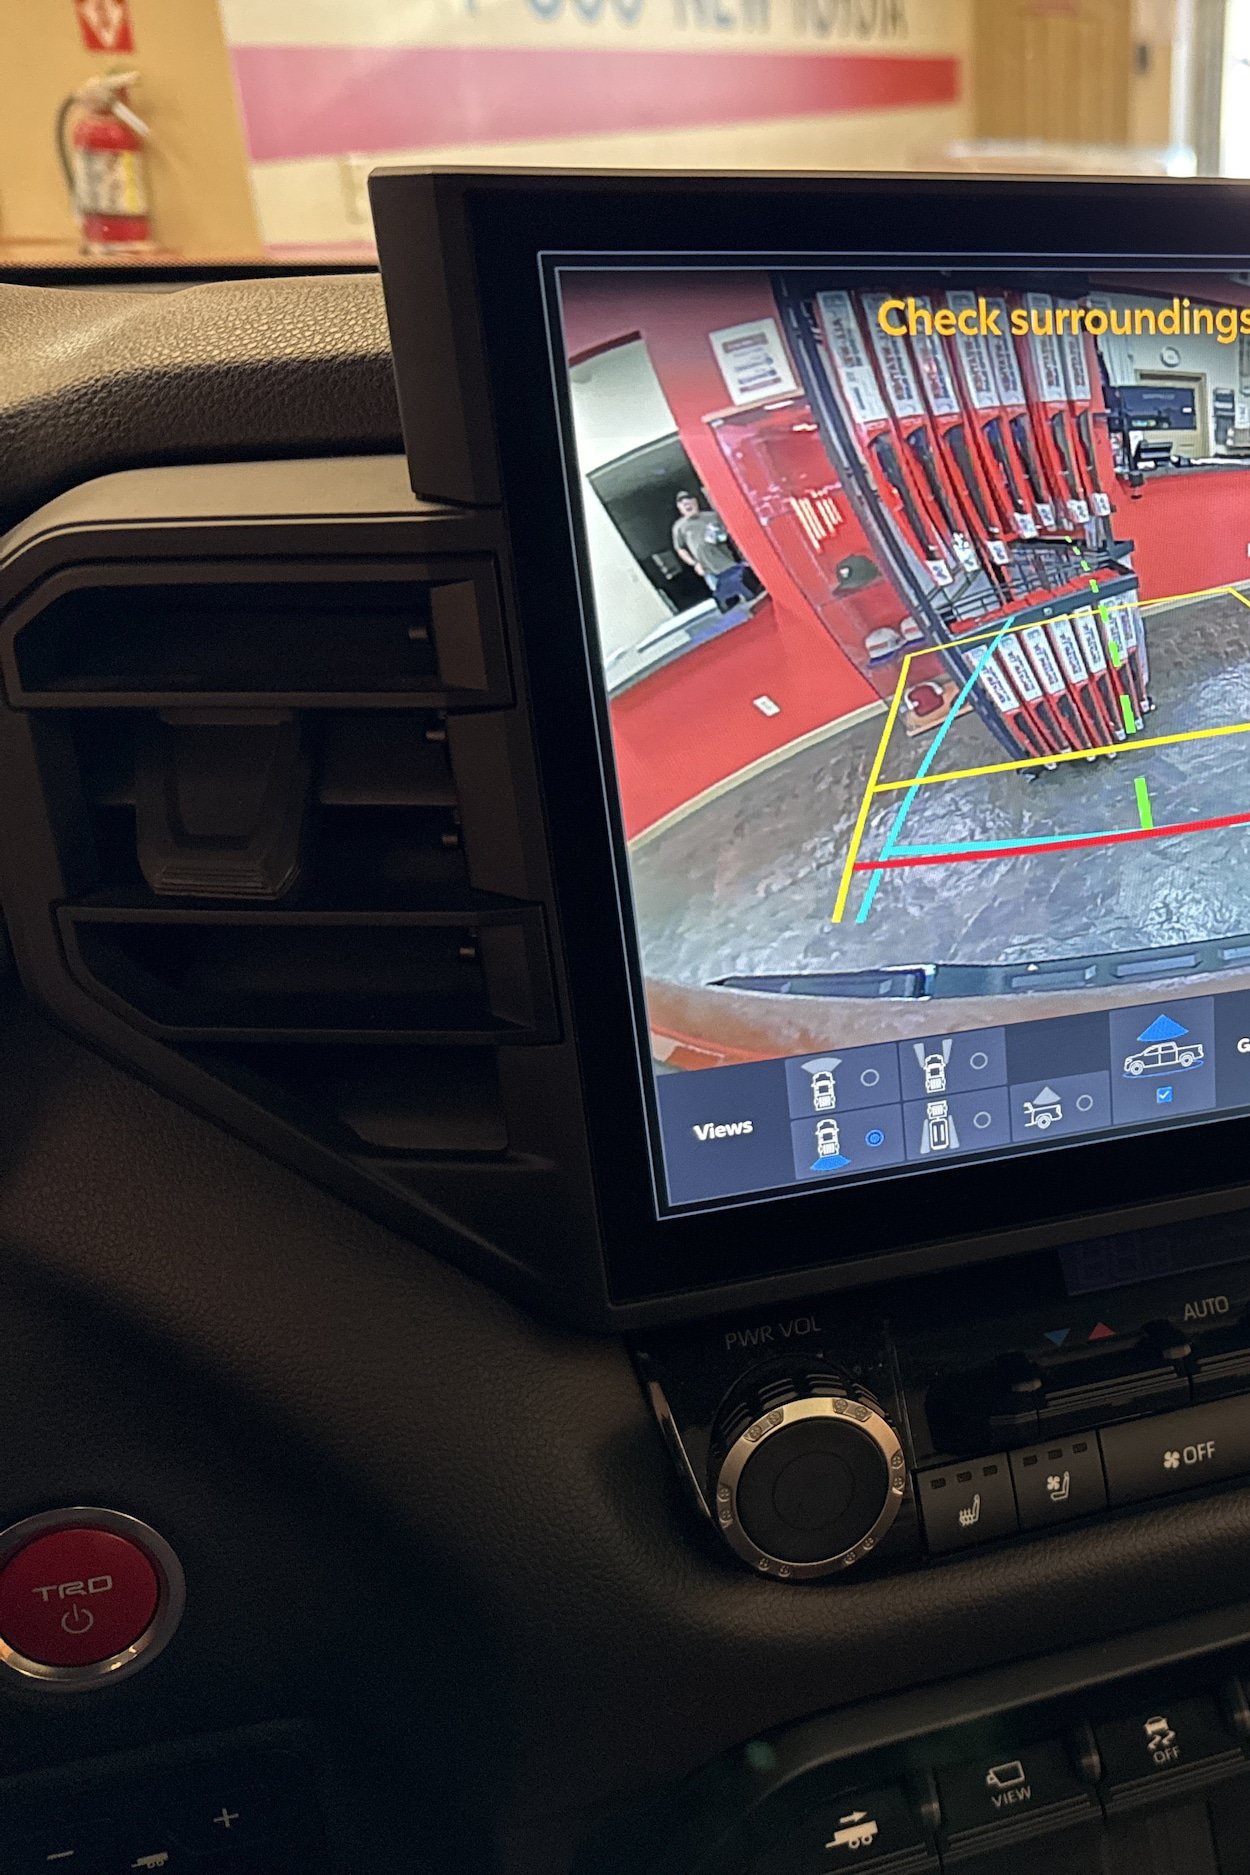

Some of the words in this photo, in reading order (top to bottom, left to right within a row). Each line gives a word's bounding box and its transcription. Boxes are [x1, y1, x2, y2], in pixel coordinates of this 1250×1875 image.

[878, 298, 1001, 337] Check
[693, 1119, 753, 1141] Views
[1183, 1296, 1230, 1321] AUTO
[725, 1325, 774, 1350] PWR
[778, 1315, 822, 1338] VOL
[1184, 1441, 1216, 1465] OFF
[32, 1574, 113, 1602] TRD
[1153, 1744, 1181, 1765] OFF
[990, 1785, 1033, 1807] VIEW
